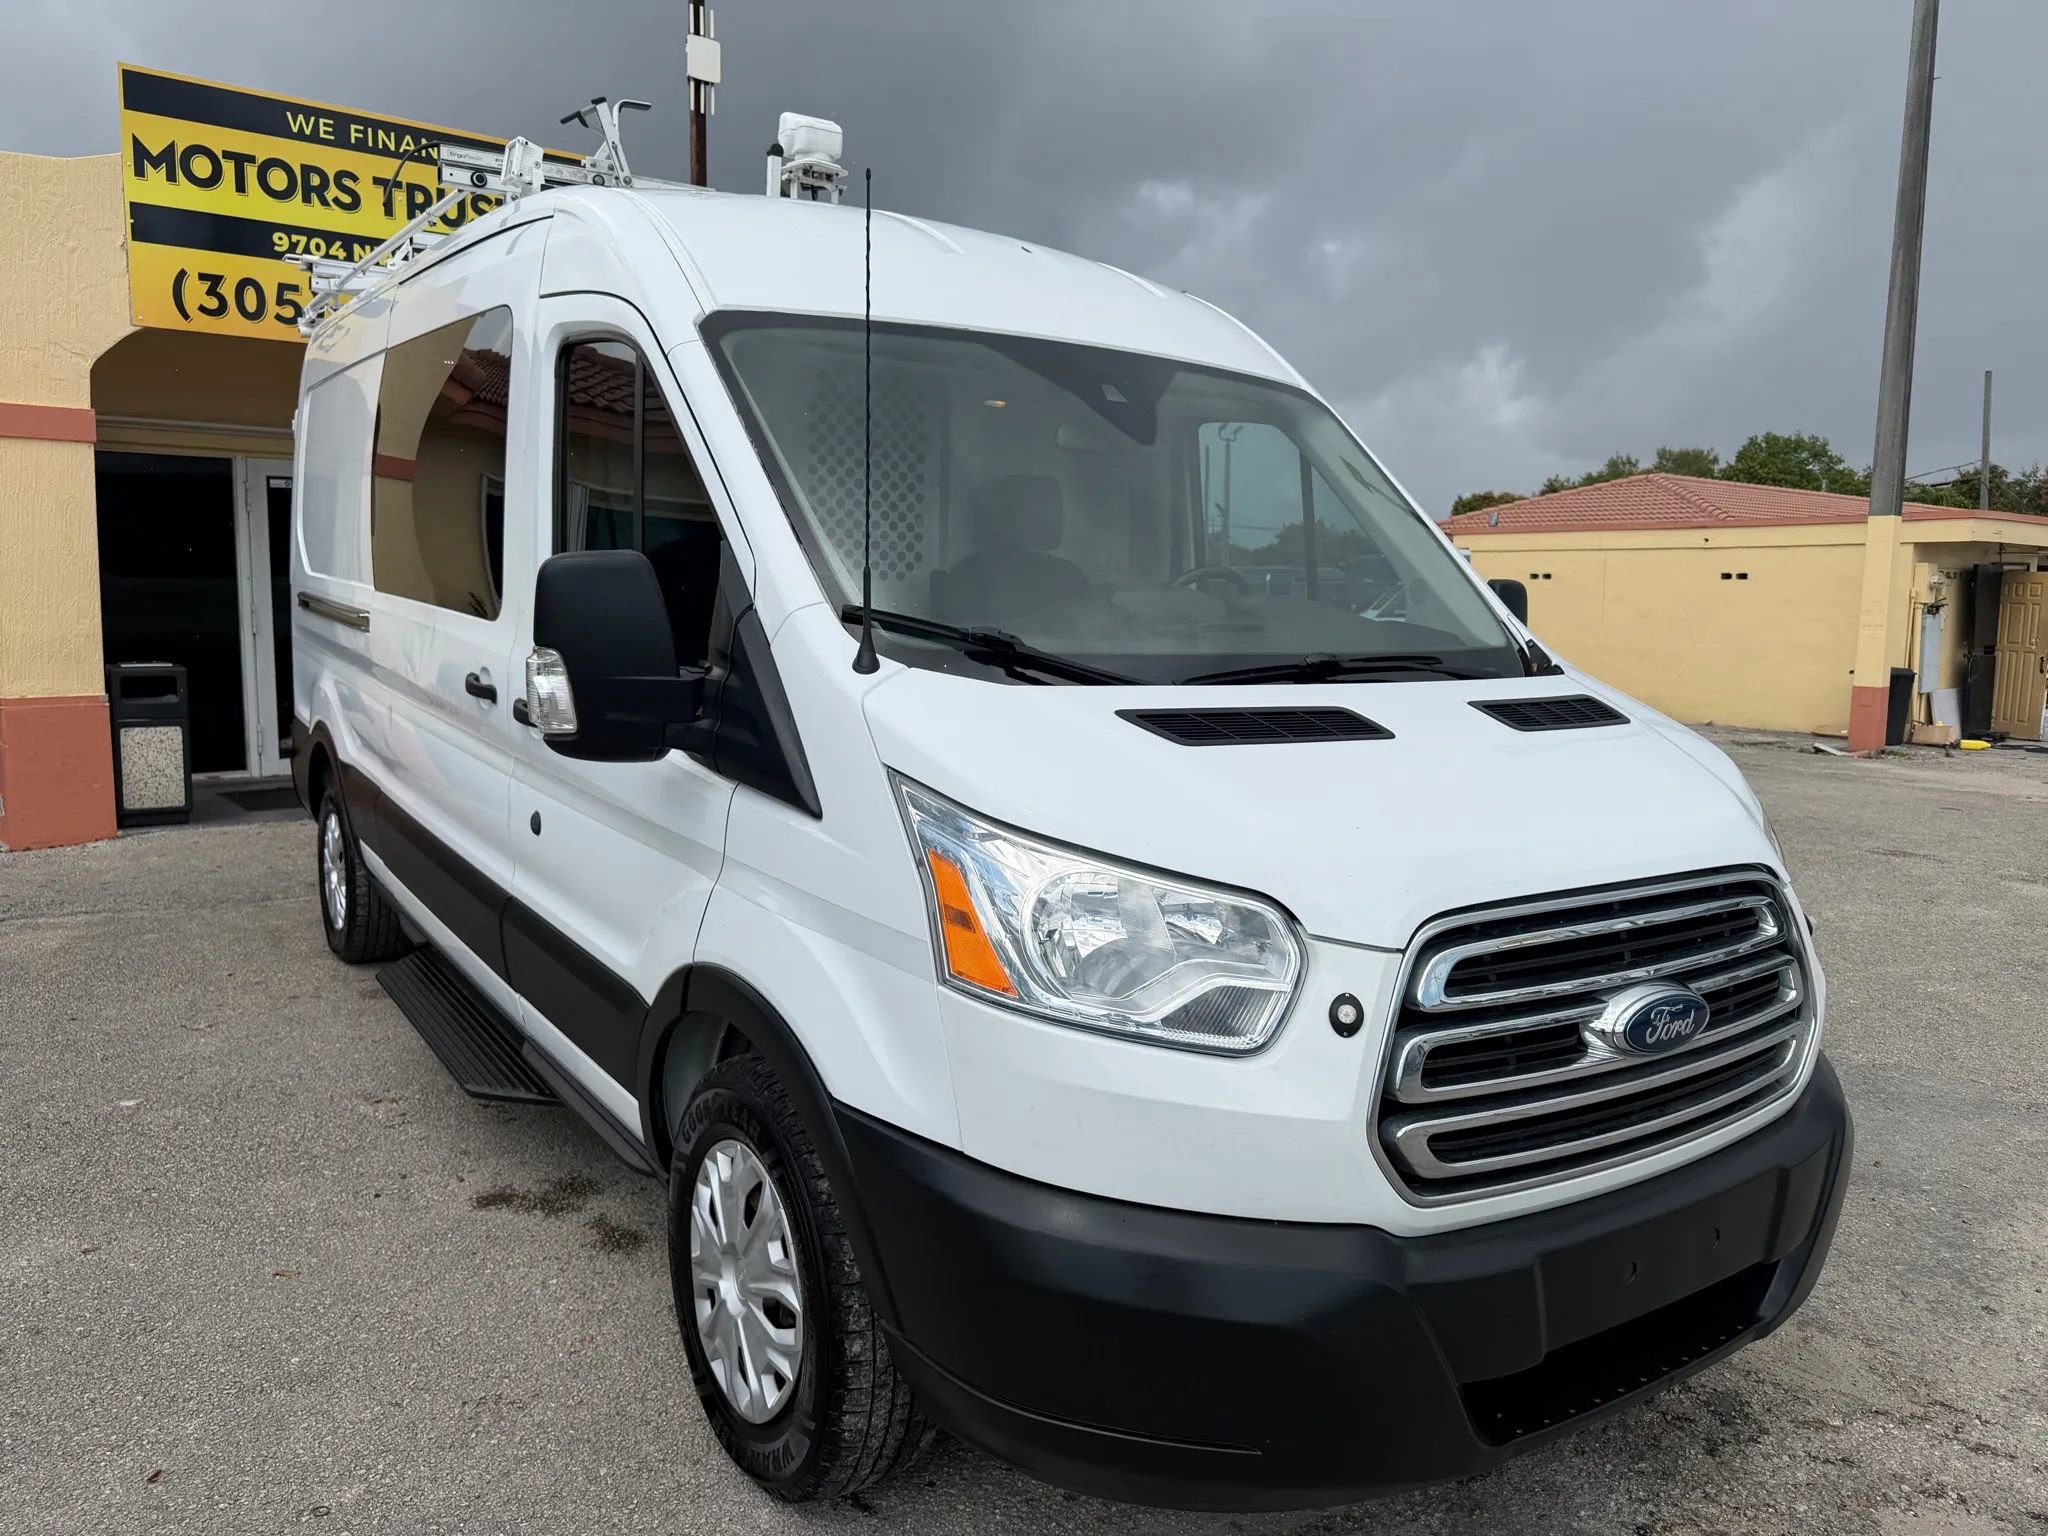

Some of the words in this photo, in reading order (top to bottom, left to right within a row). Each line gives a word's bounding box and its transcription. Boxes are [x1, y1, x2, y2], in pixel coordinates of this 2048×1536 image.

[286, 111, 335, 140] WE
[132, 132, 362, 214] MOTORS
[372, 176, 504, 229] TRUS
[272, 231, 347, 261] 9704
[1645, 1003, 1695, 1044] Ford
